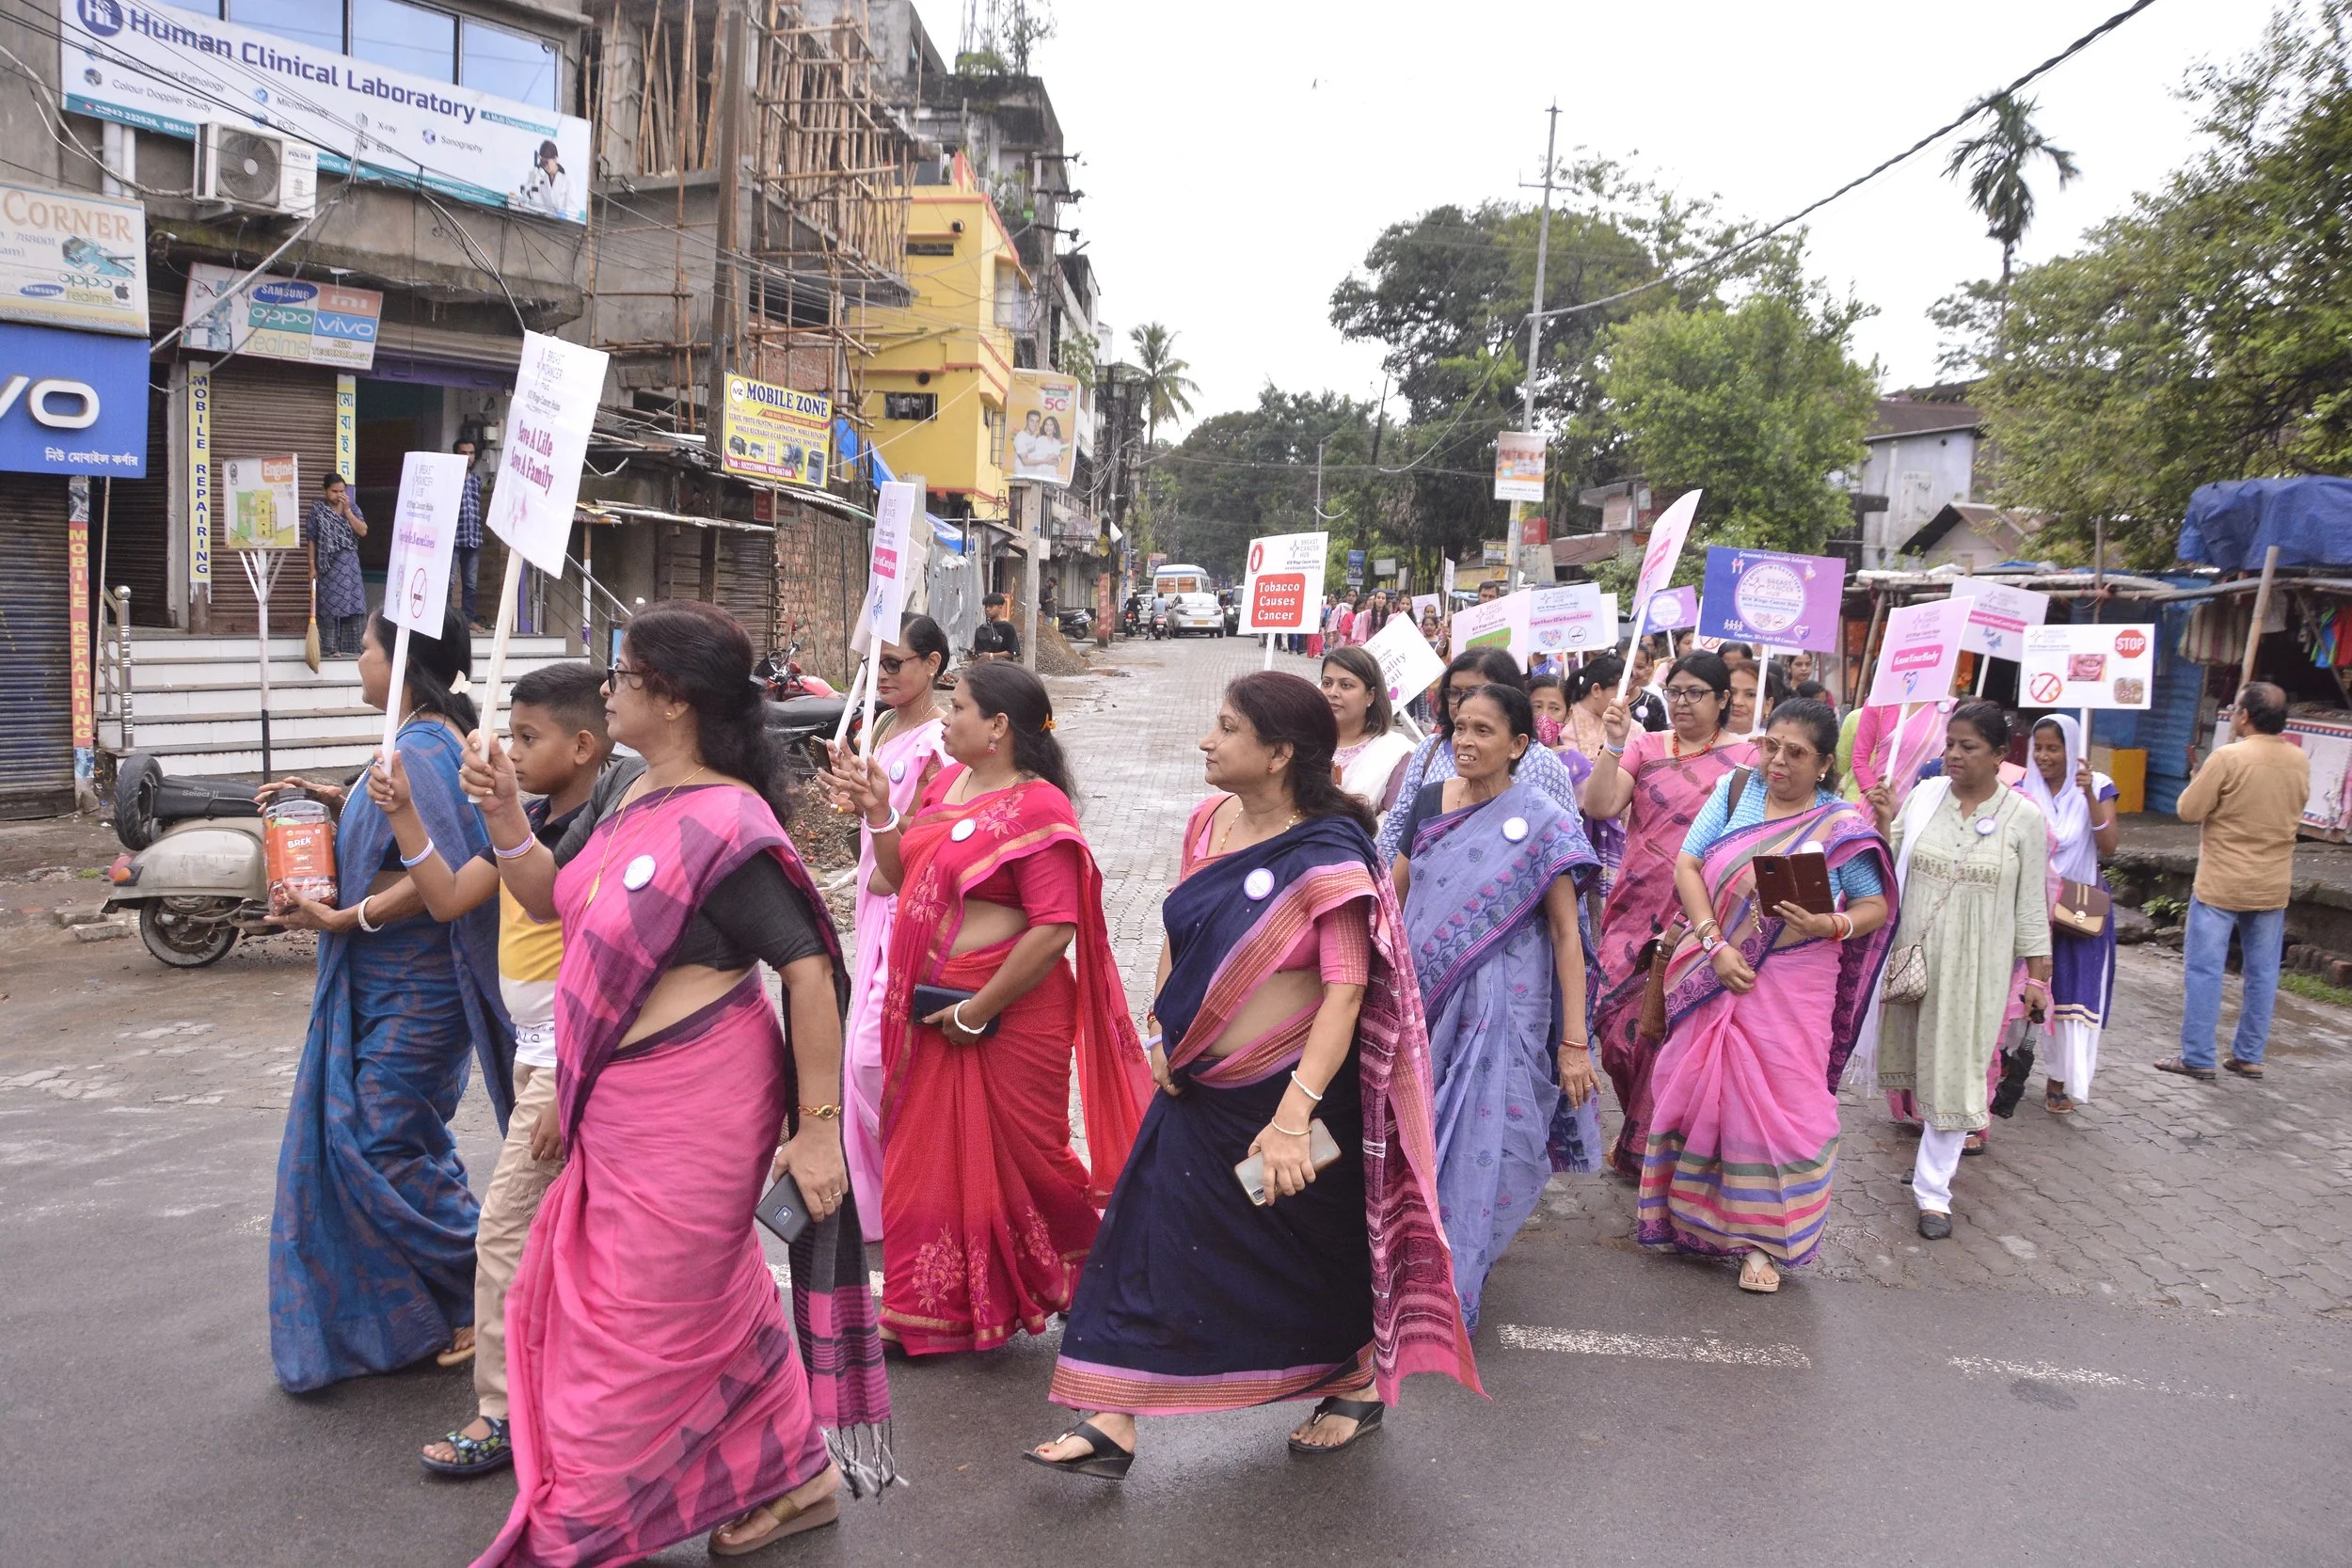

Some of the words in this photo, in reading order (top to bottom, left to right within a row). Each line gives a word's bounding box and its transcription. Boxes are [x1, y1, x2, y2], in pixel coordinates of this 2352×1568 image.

[131, 8, 232, 58] Human
[242, 41, 338, 87] Clinical
[347, 70, 476, 124] Laboratory
[181, 71, 225, 92] Pathology
[112, 79, 143, 95] Colour
[147, 87, 183, 104] Doppler
[186, 98, 212, 113] Study
[378, 120, 397, 134] X-ray
[440, 135, 484, 153] Sonography
[4, 190, 135, 242] CORNER
[58, 273, 113, 289] oppo
[261, 284, 310, 299] SAMSUNG
[67, 289, 114, 305] realme
[251, 307, 312, 325] oppo
[318, 316, 373, 337] vivo
[247, 333, 308, 356] realme
[746, 382, 793, 410] MOBILE
[796, 395, 827, 418] ZONE
[194, 375, 208, 449] MOBILE
[519, 420, 530, 447] Save
[530, 433, 536, 449] A
[536, 430, 553, 458] Life
[45, 447, 65, 462] নিউ
[69, 450, 108, 466] মোবাইল
[521, 458, 527, 476] A
[528, 455, 553, 497] Family
[195, 465, 208, 574] REPAIRING
[69, 530, 88, 609] MOBILE
[1259, 581, 1300, 593] Tobacco
[1260, 595, 1295, 607] Causes
[1258, 610, 1295, 621] Cancer
[2116, 638, 2144, 651] STOP
[72, 621, 91, 739] REPAIRING
[287, 836, 311, 848] BREK
